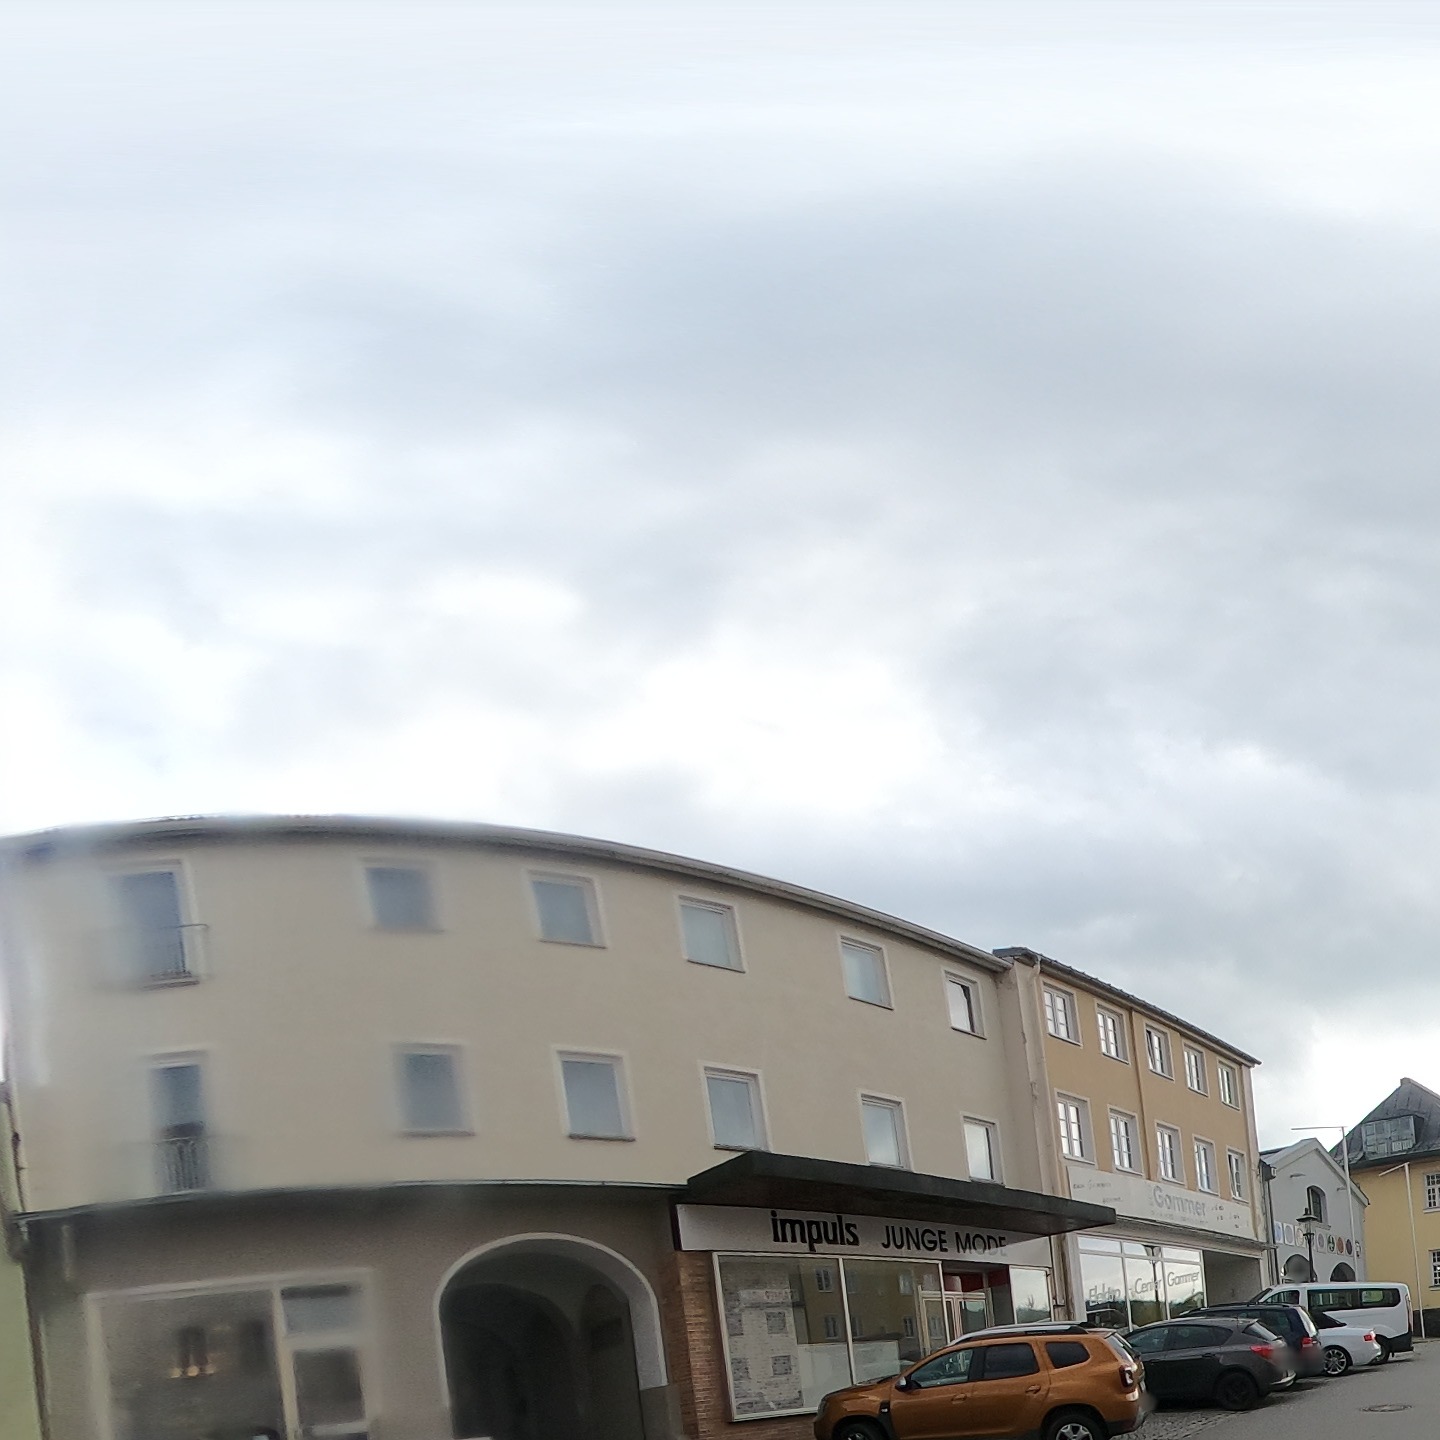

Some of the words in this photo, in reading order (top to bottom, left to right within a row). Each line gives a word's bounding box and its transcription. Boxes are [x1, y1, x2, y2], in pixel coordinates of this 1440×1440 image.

[1153, 1185, 1206, 1217] Gammer
[770, 1210, 859, 1252] impuls
[881, 1225, 948, 1252] JUNGE
[954, 1231, 1008, 1257] MODE
[1167, 1271, 1201, 1287] Gammer
